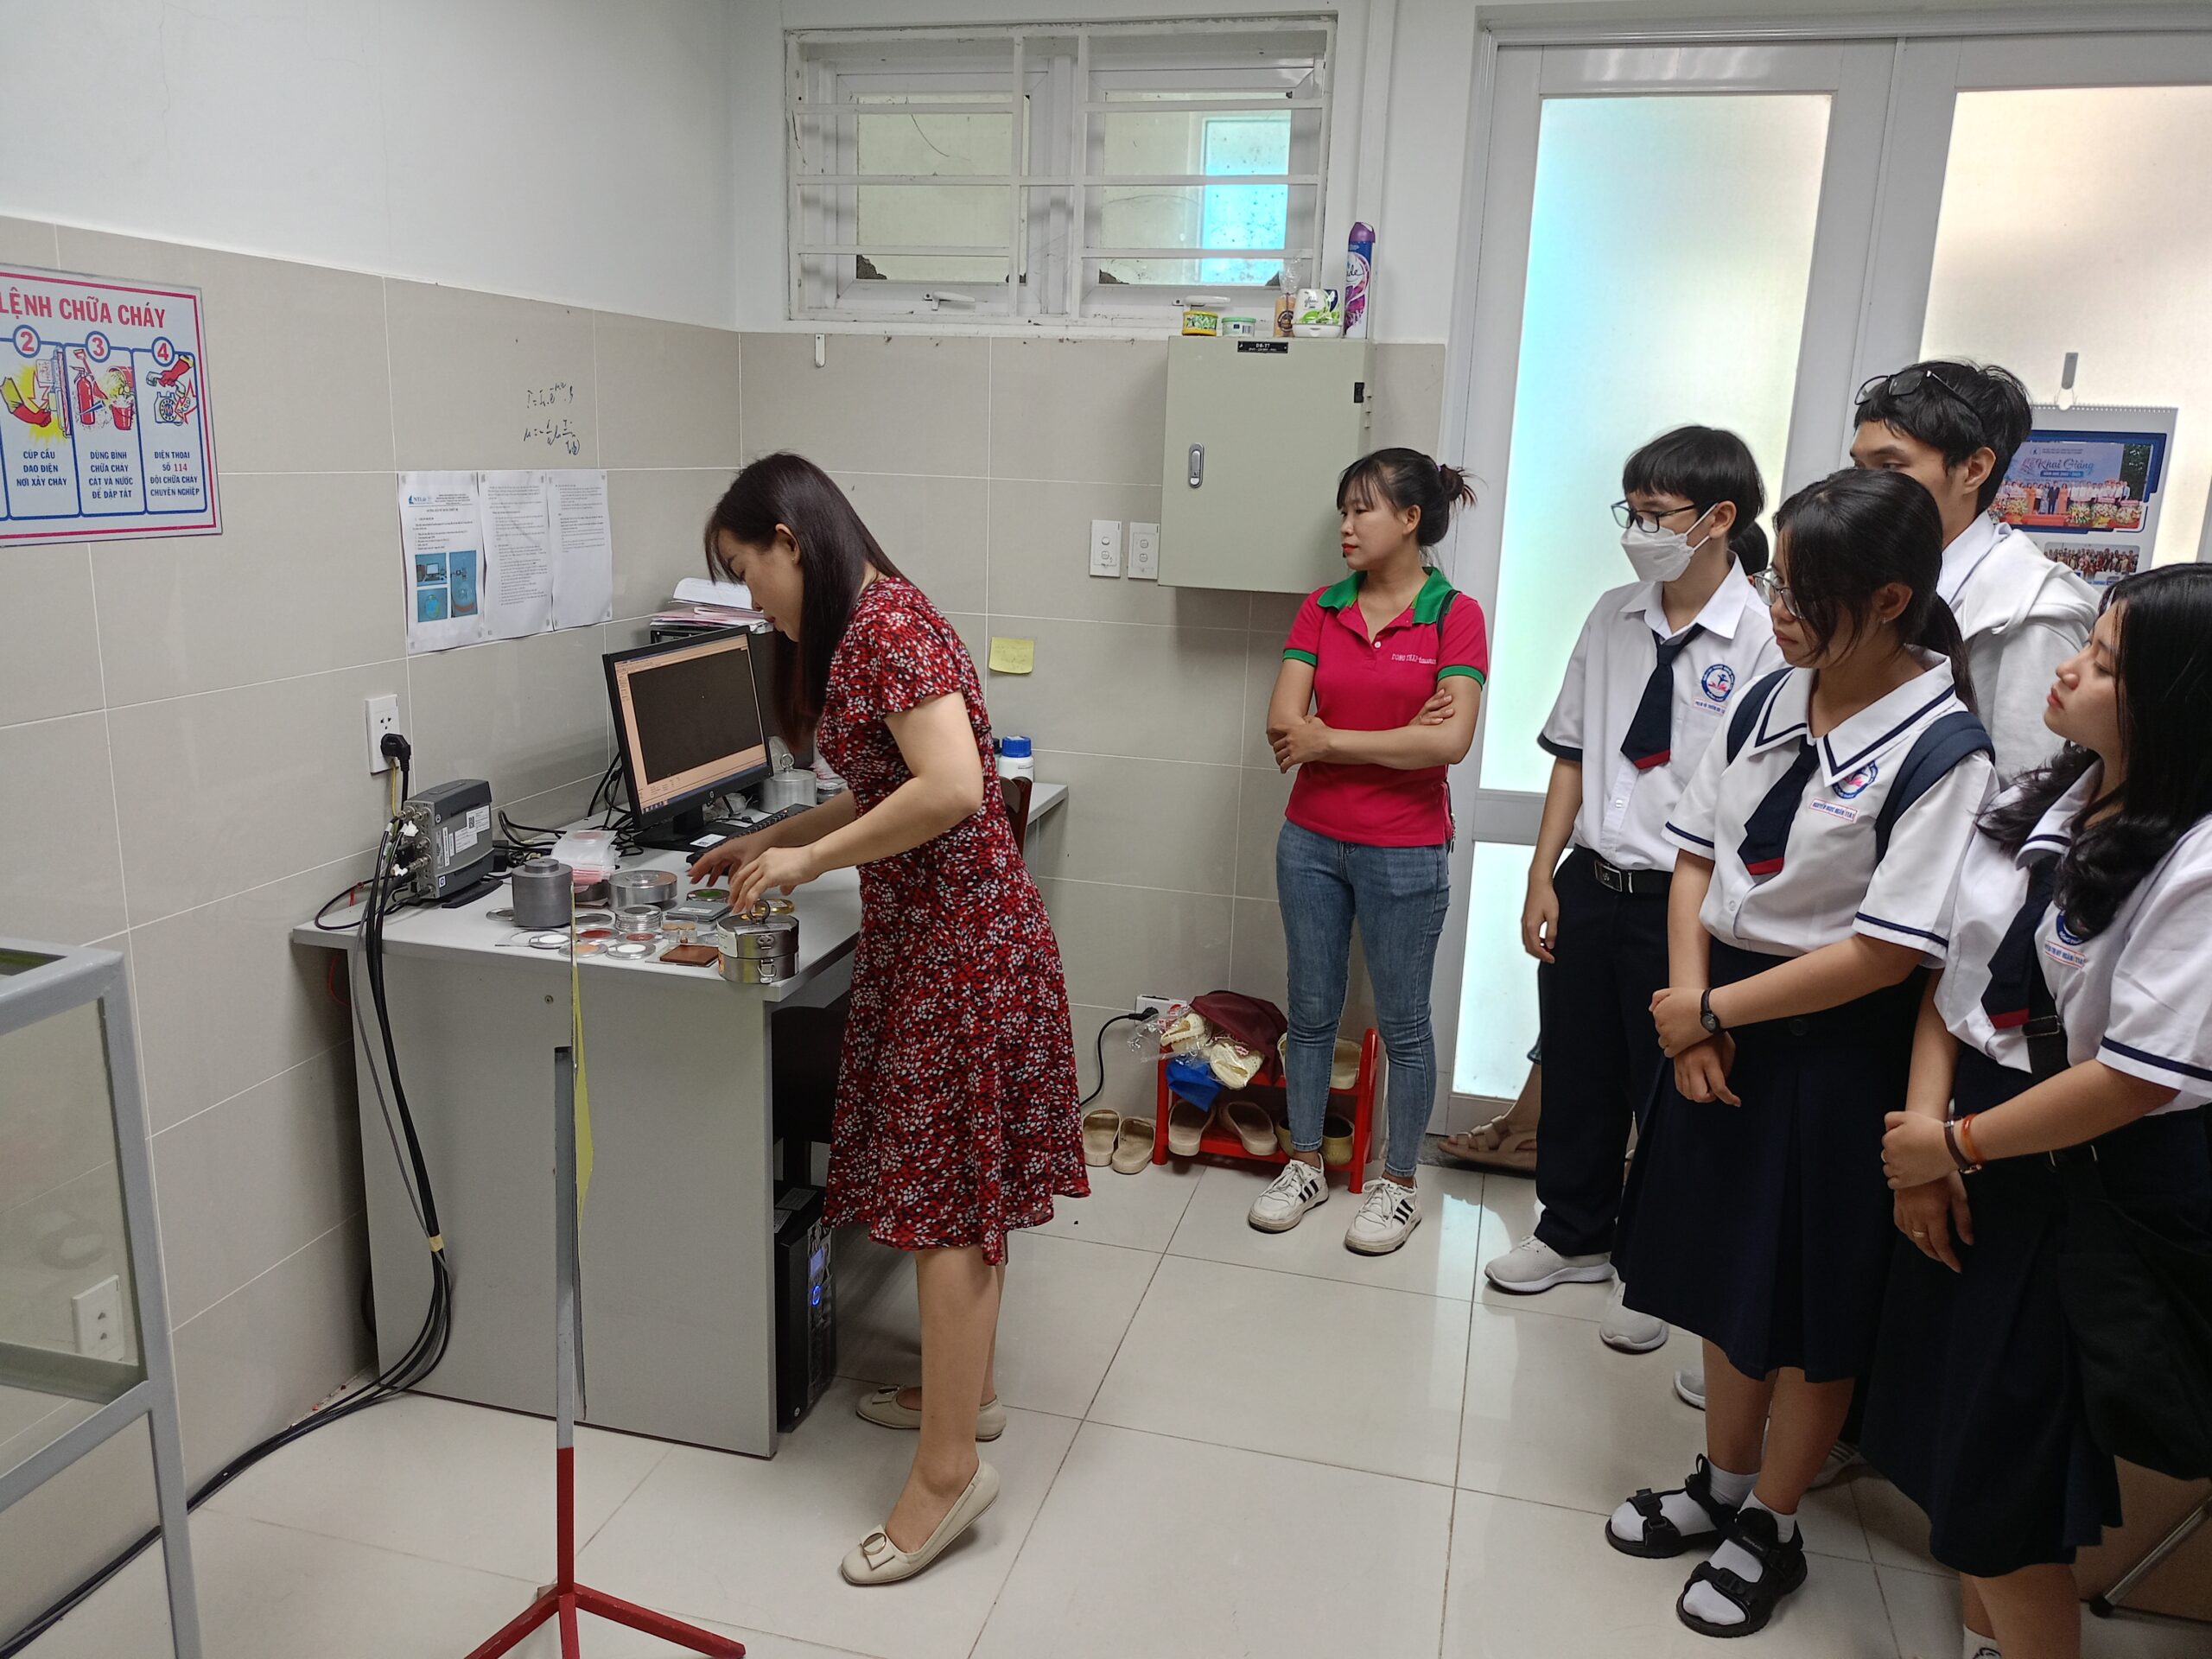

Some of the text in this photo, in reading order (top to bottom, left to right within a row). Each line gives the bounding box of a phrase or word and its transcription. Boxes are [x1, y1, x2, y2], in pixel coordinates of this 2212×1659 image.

[59, 296, 112, 324] CHỮA
[118, 302, 165, 328] CHÁY
[20, 331, 35, 352] 2
[92, 336, 105, 357] 3
[157, 342, 169, 361] 4
[174, 462, 188, 473] 114
